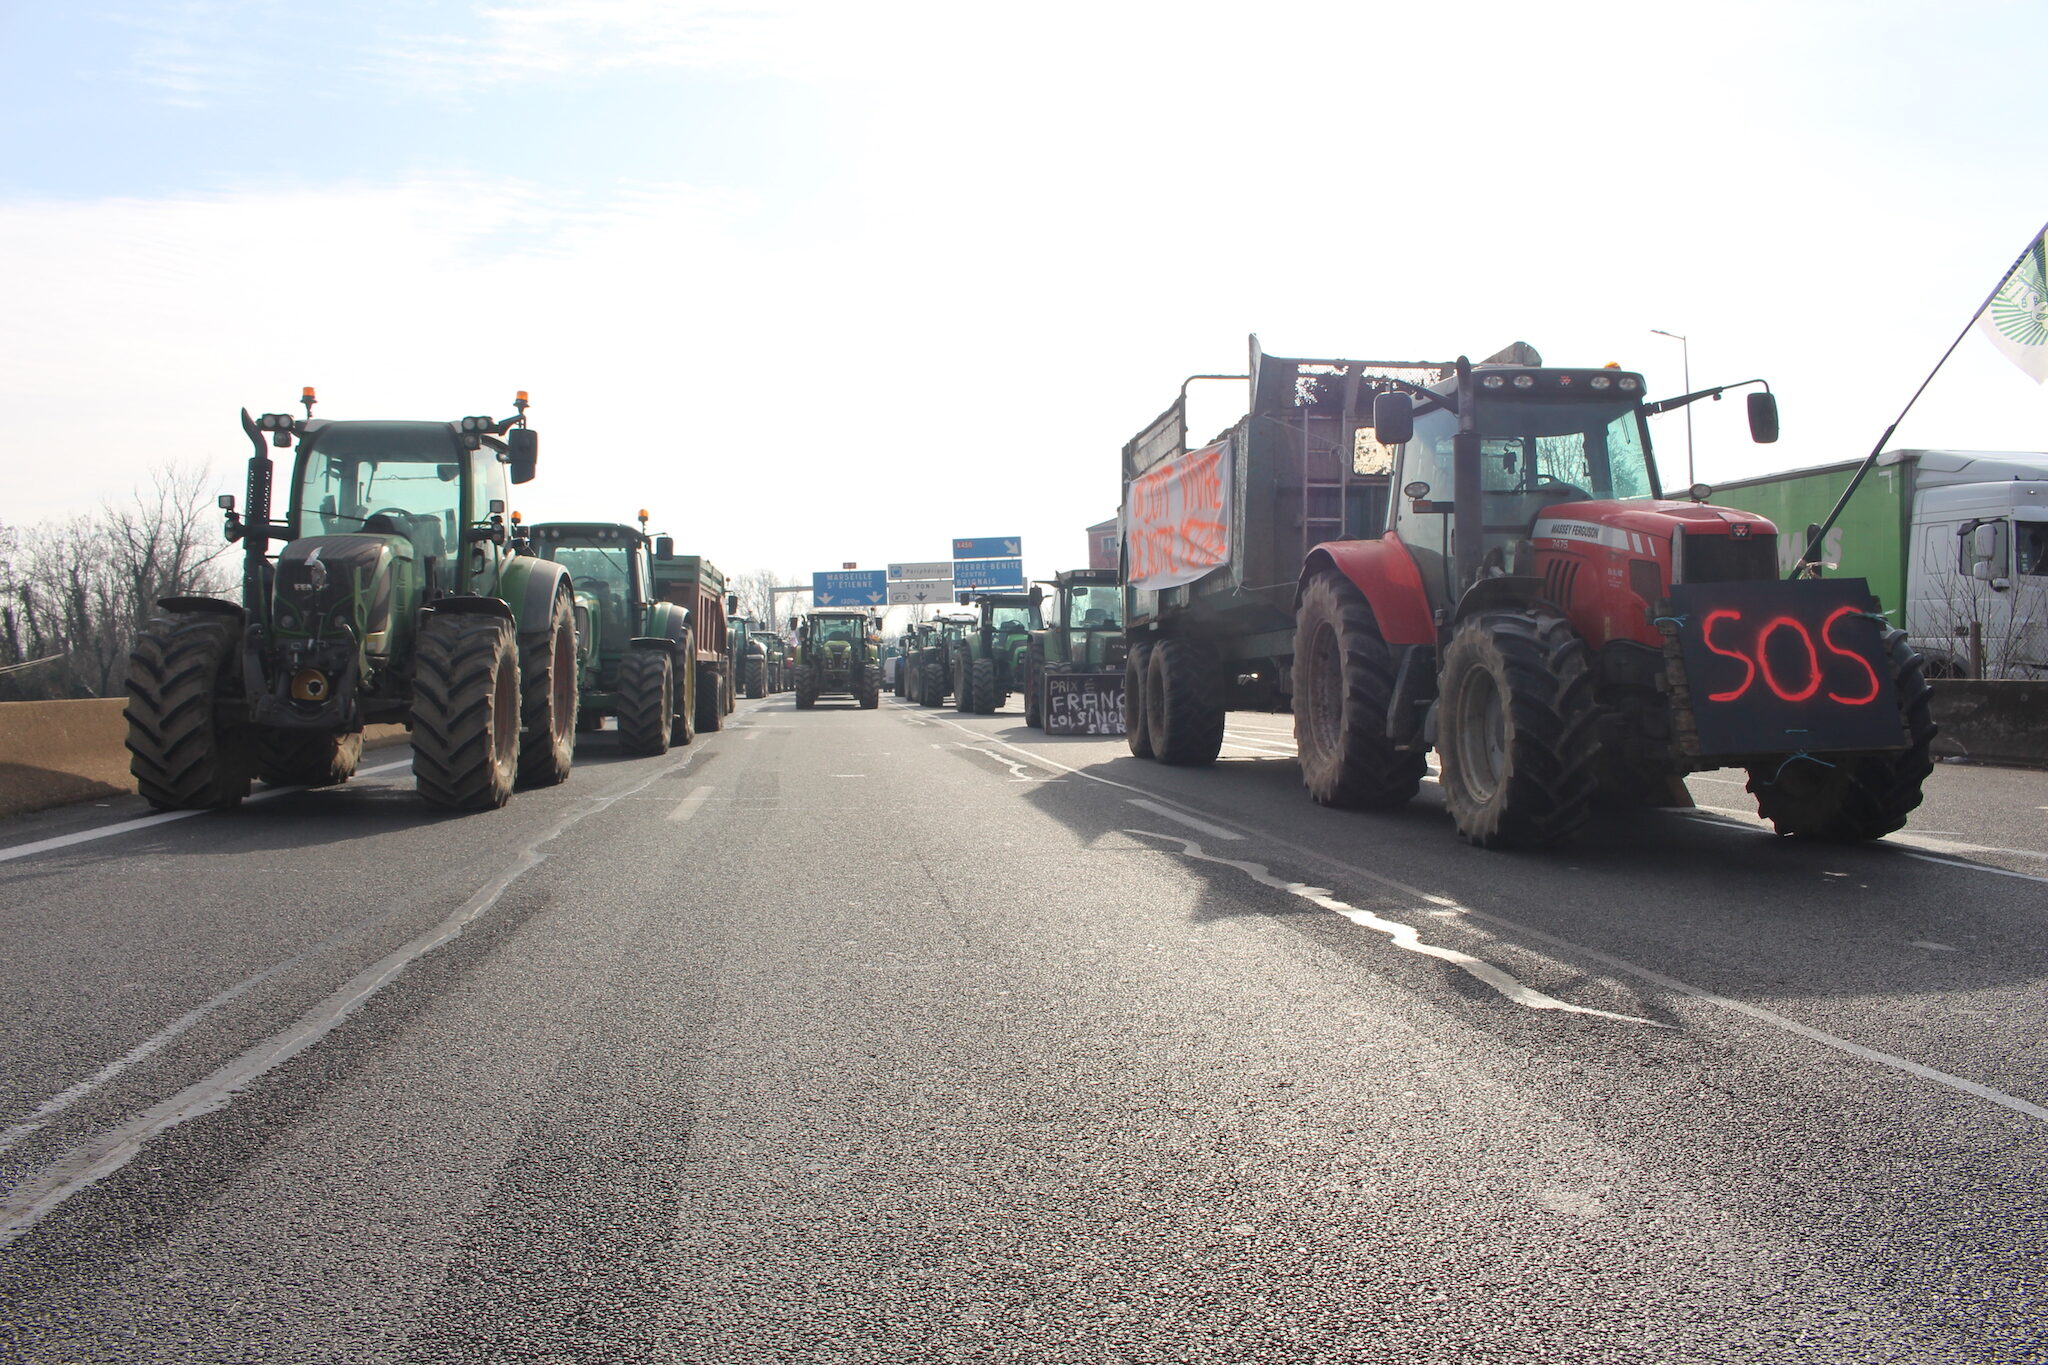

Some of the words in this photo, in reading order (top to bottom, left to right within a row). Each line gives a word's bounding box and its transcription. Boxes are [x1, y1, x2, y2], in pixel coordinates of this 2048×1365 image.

[1551, 523, 1572, 535] MASSEY
[1571, 525, 1600, 540] FERGUSON
[1552, 539, 1569, 549] 7475
[826, 573, 873, 581] MARSEILLE
[956, 577, 997, 587] BRIGNAIS
[1703, 605, 1880, 705] SOS
